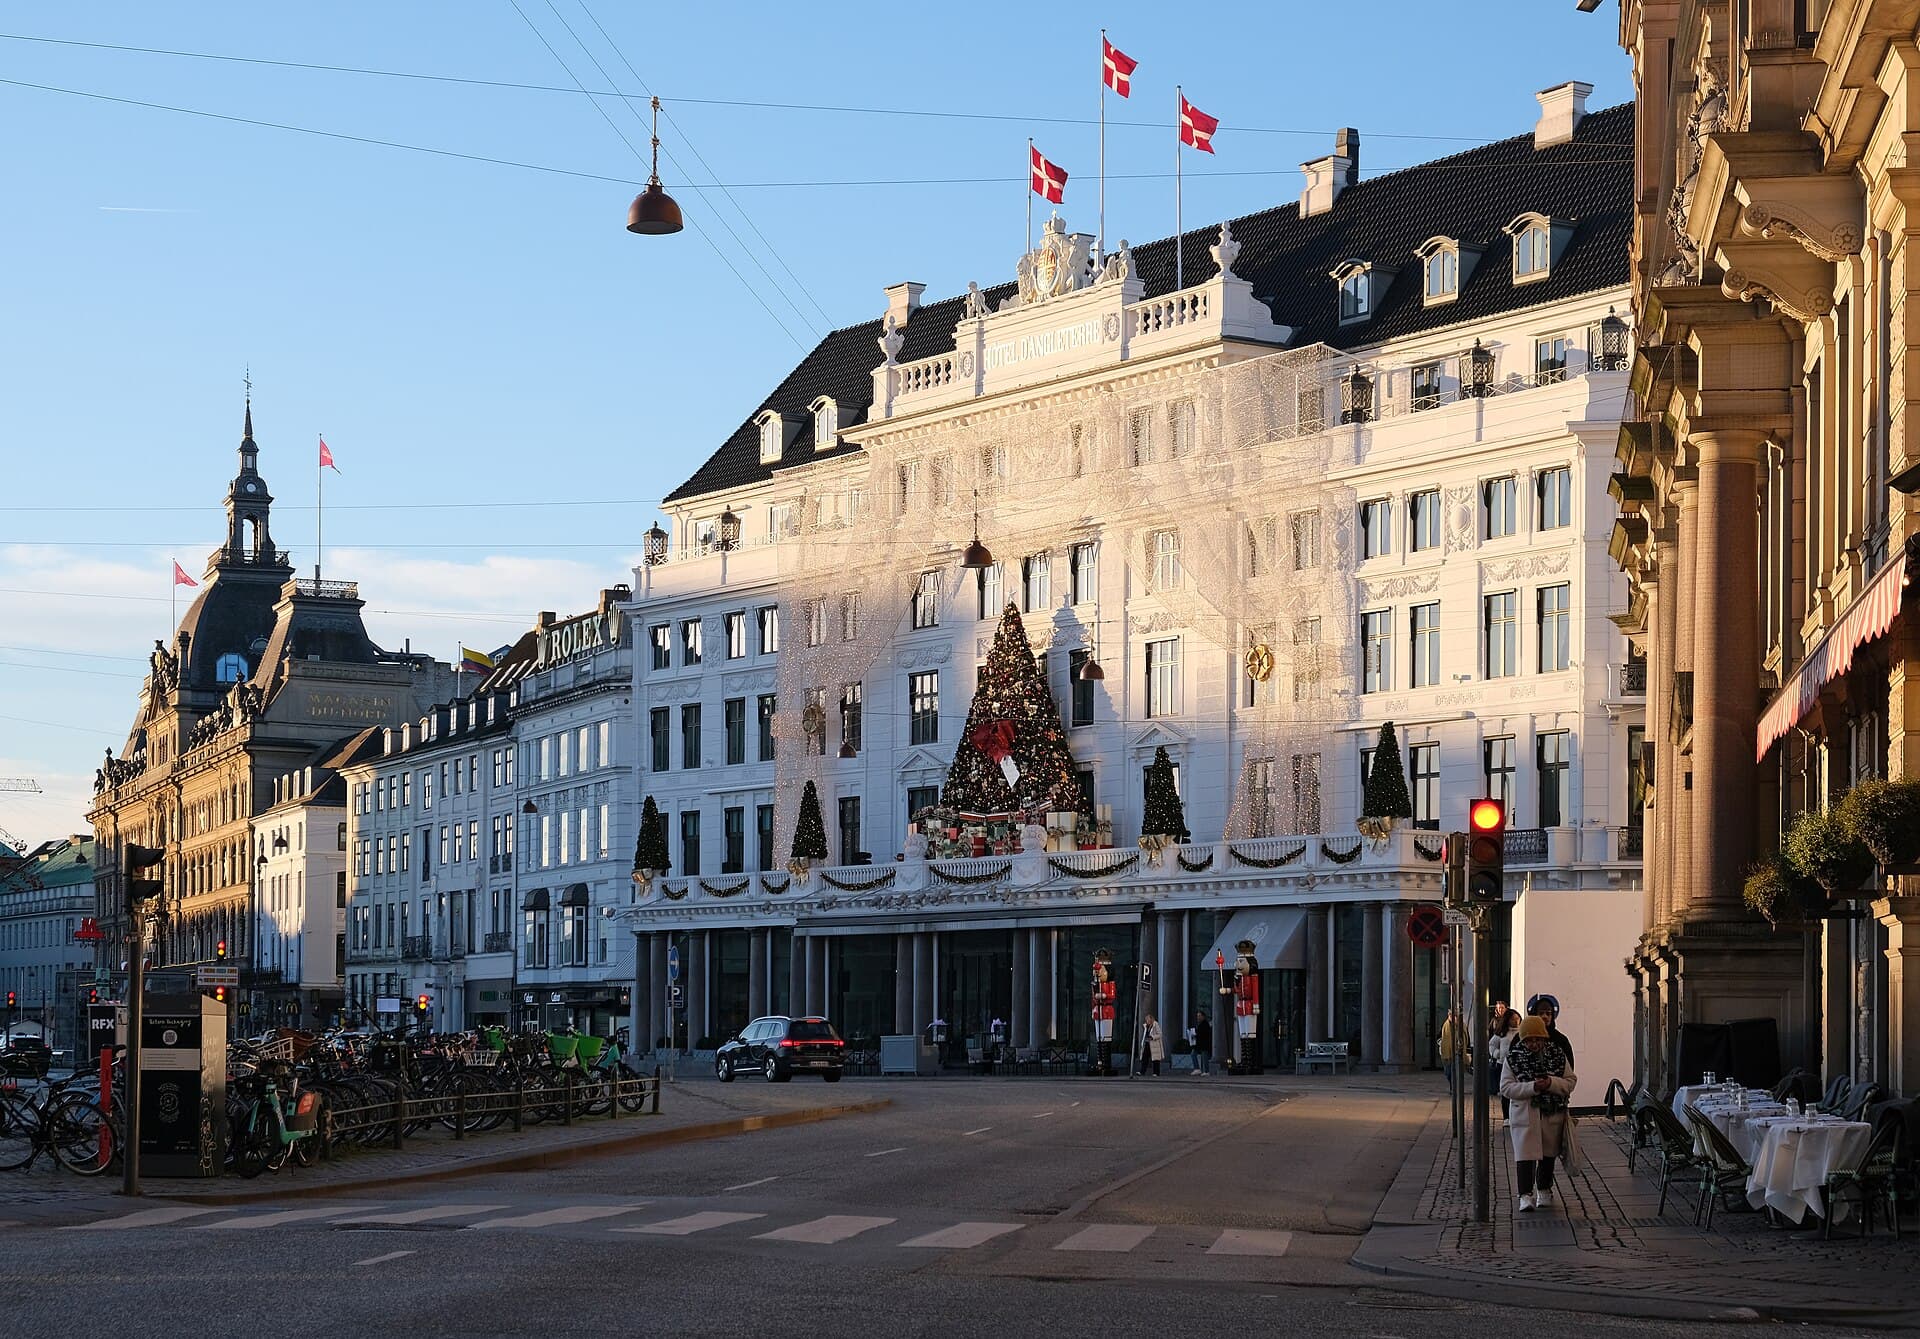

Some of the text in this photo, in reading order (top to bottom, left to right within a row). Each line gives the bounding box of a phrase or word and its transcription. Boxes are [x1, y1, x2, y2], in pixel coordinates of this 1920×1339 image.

[551, 614, 603, 661] ROLEX
[1143, 965, 1150, 981] P
[672, 987, 681, 997] P
[91, 1018, 115, 1030] RFX
